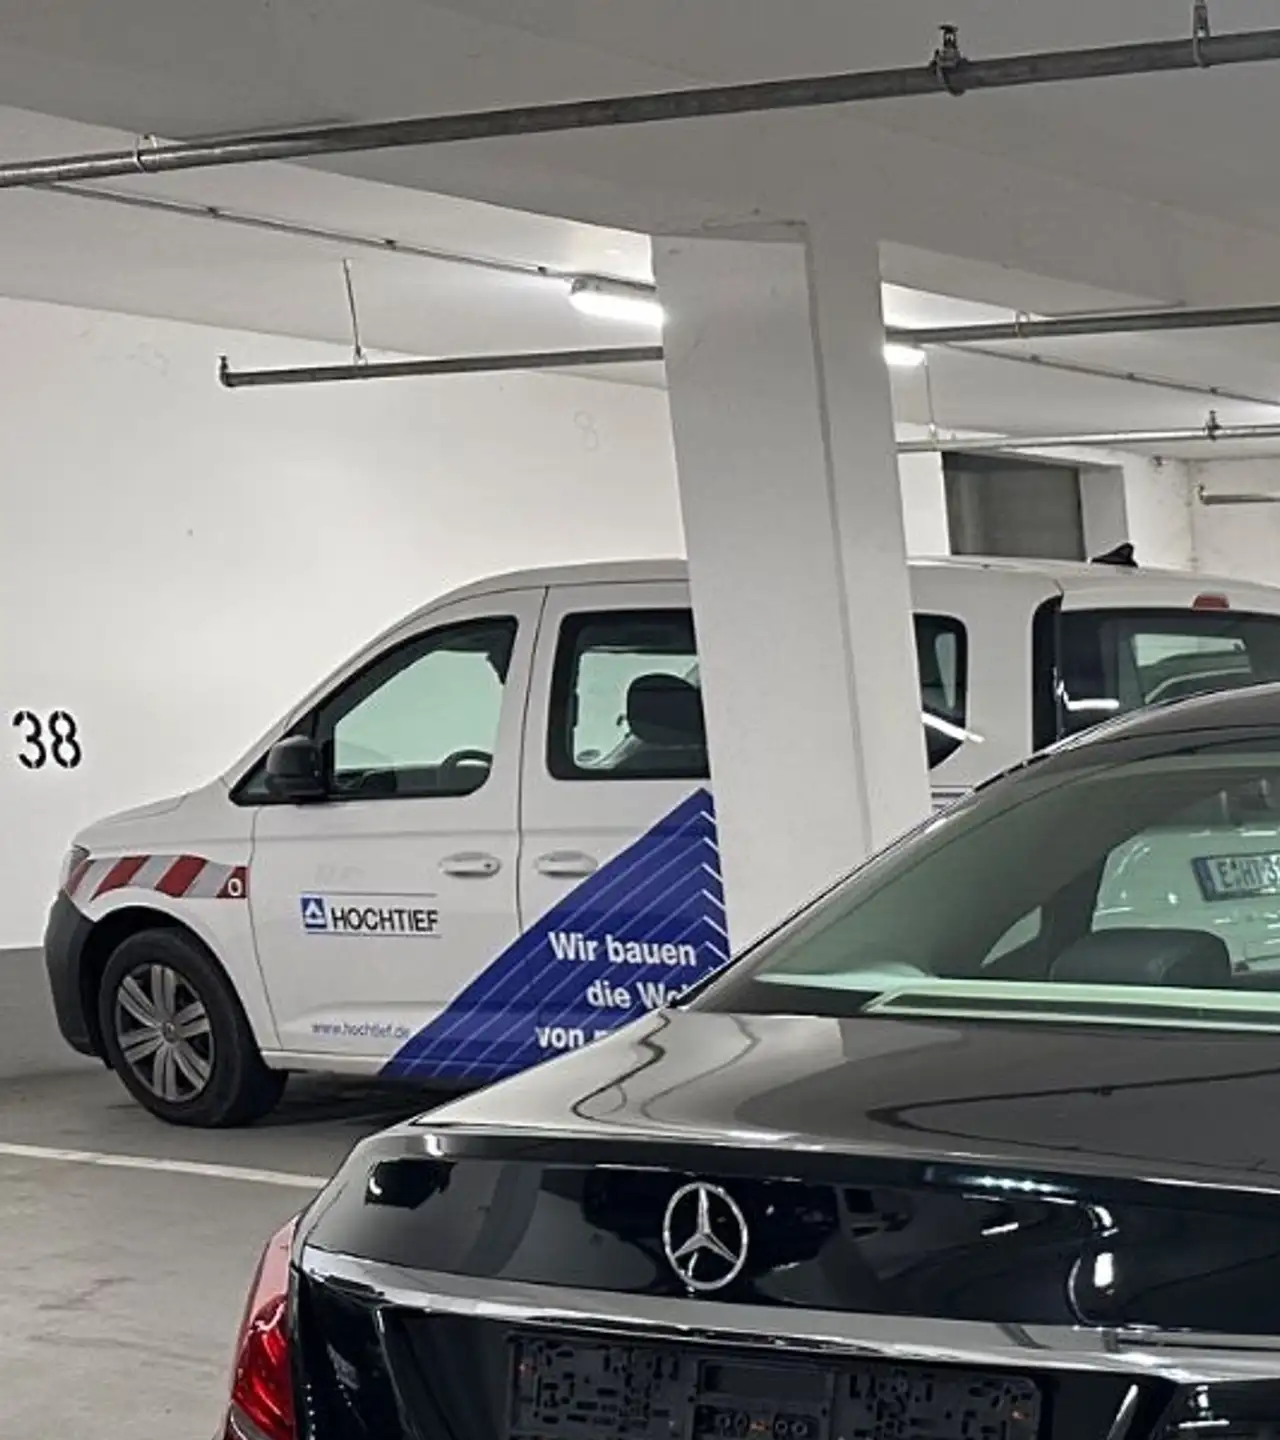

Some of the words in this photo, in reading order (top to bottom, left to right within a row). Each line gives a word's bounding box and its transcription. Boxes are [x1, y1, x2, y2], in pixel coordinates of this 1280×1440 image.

[12, 710, 82, 769] 38
[330, 907, 439, 932] HOCHTIEF
[548, 931, 599, 961] Wir
[605, 934, 697, 967] bauen
[586, 979, 630, 1008] die
[535, 1026, 584, 1049] von
